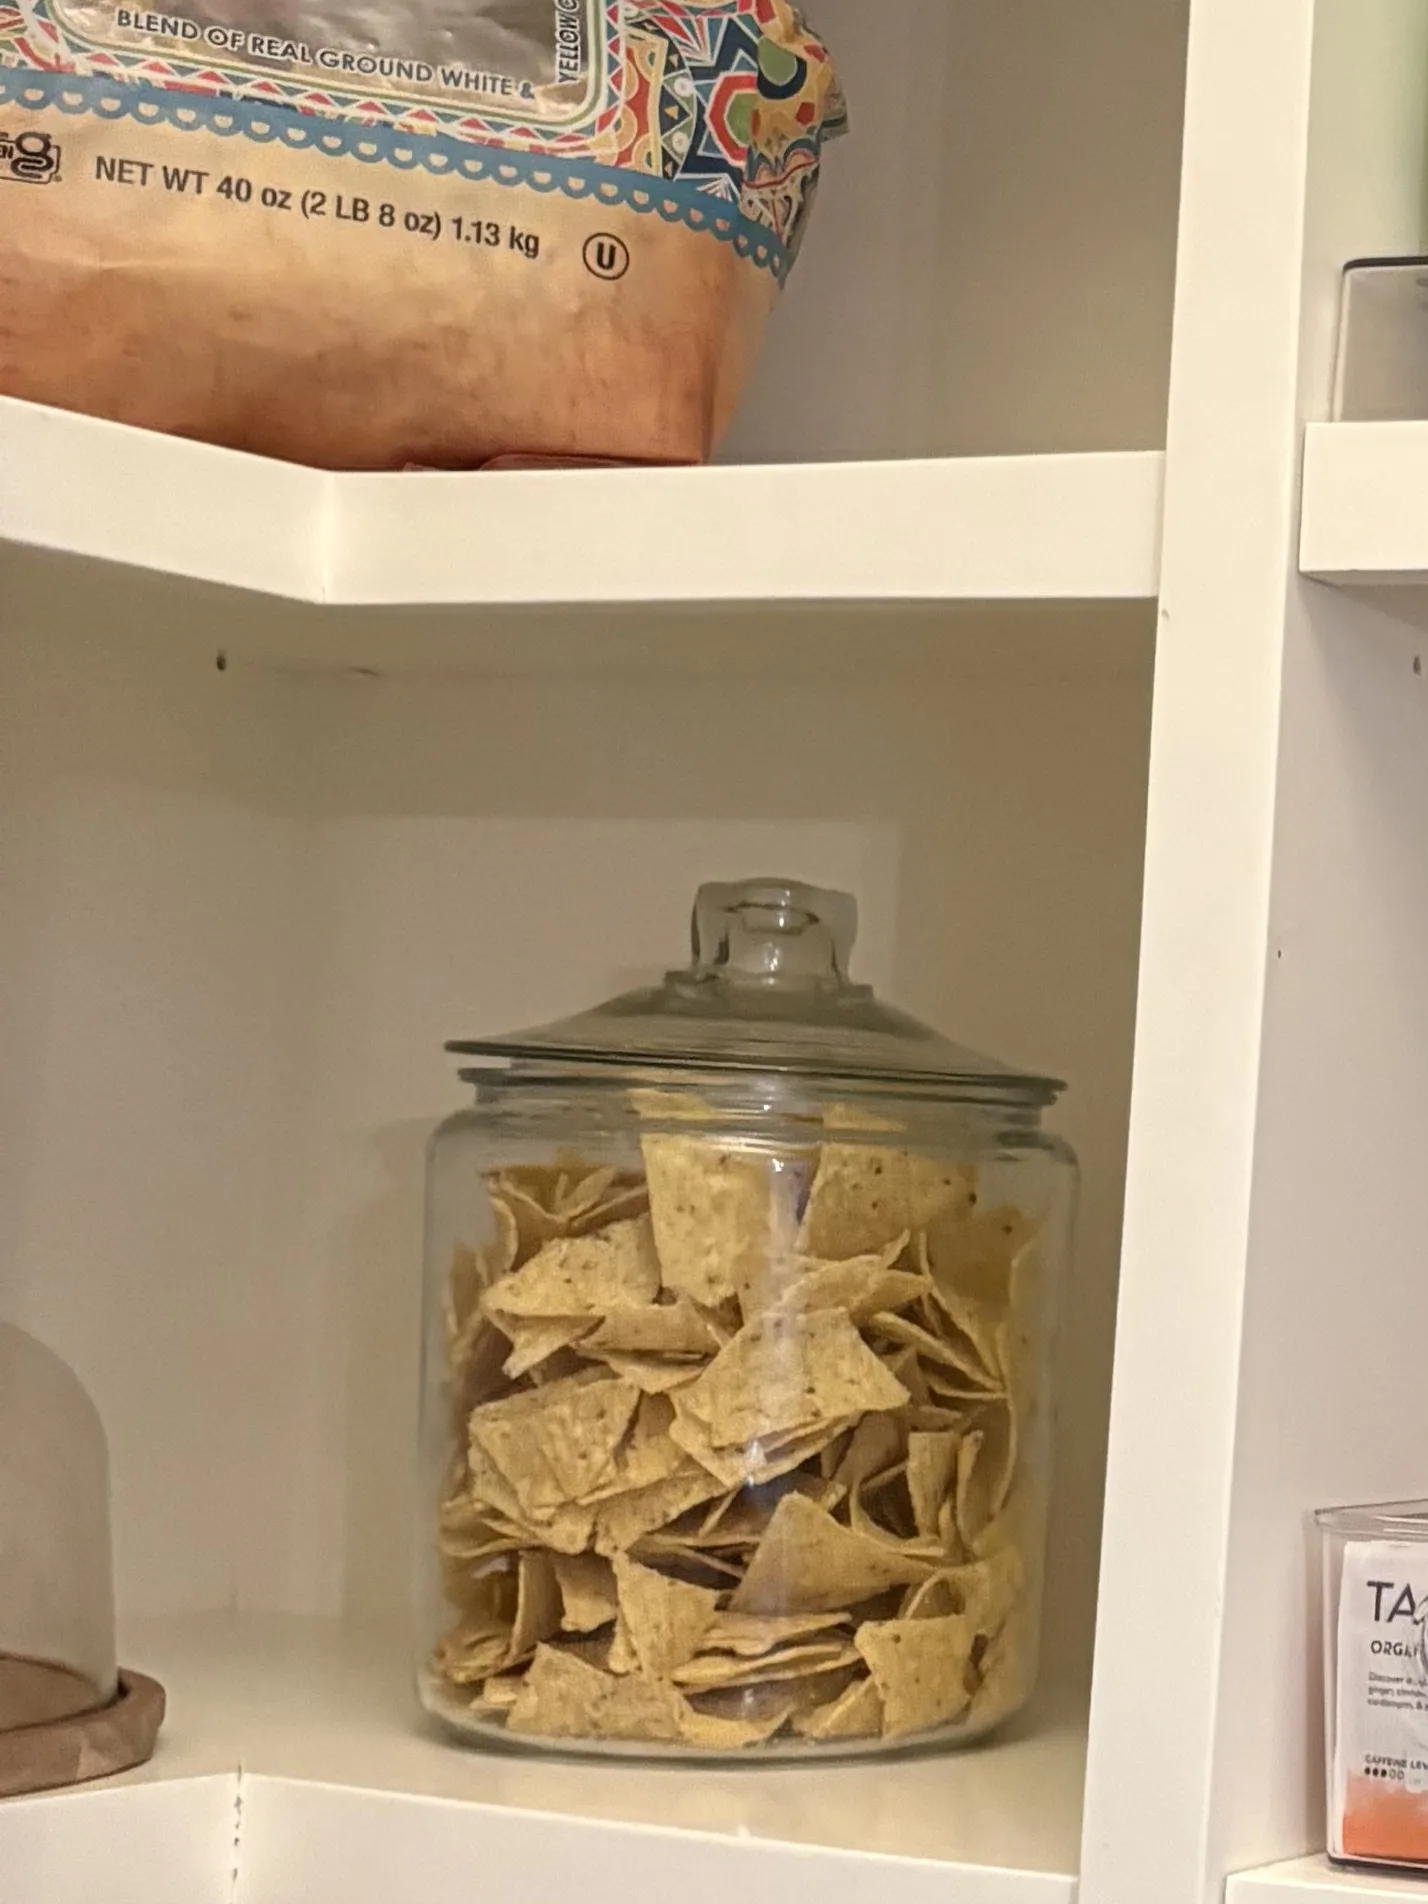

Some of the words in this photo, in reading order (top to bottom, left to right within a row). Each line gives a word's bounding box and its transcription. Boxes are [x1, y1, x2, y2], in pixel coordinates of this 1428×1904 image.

[116, 8, 199, 42] BLEND
[204, 26, 246, 51] OF
[250, 34, 312, 65] REAL
[318, 50, 433, 85] GROUND
[440, 65, 513, 96] WHITE
[556, 11, 580, 84] YELLOW
[95, 155, 155, 187] NET
[162, 164, 210, 196] WT
[216, 174, 253, 204] 40
[260, 187, 292, 211] oz
[301, 188, 327, 222] (2
[335, 196, 370, 225] LB
[379, 204, 397, 228] 8
[404, 209, 442, 242] oz)
[450, 216, 501, 249] 1.13
[508, 226, 540, 260] kg
